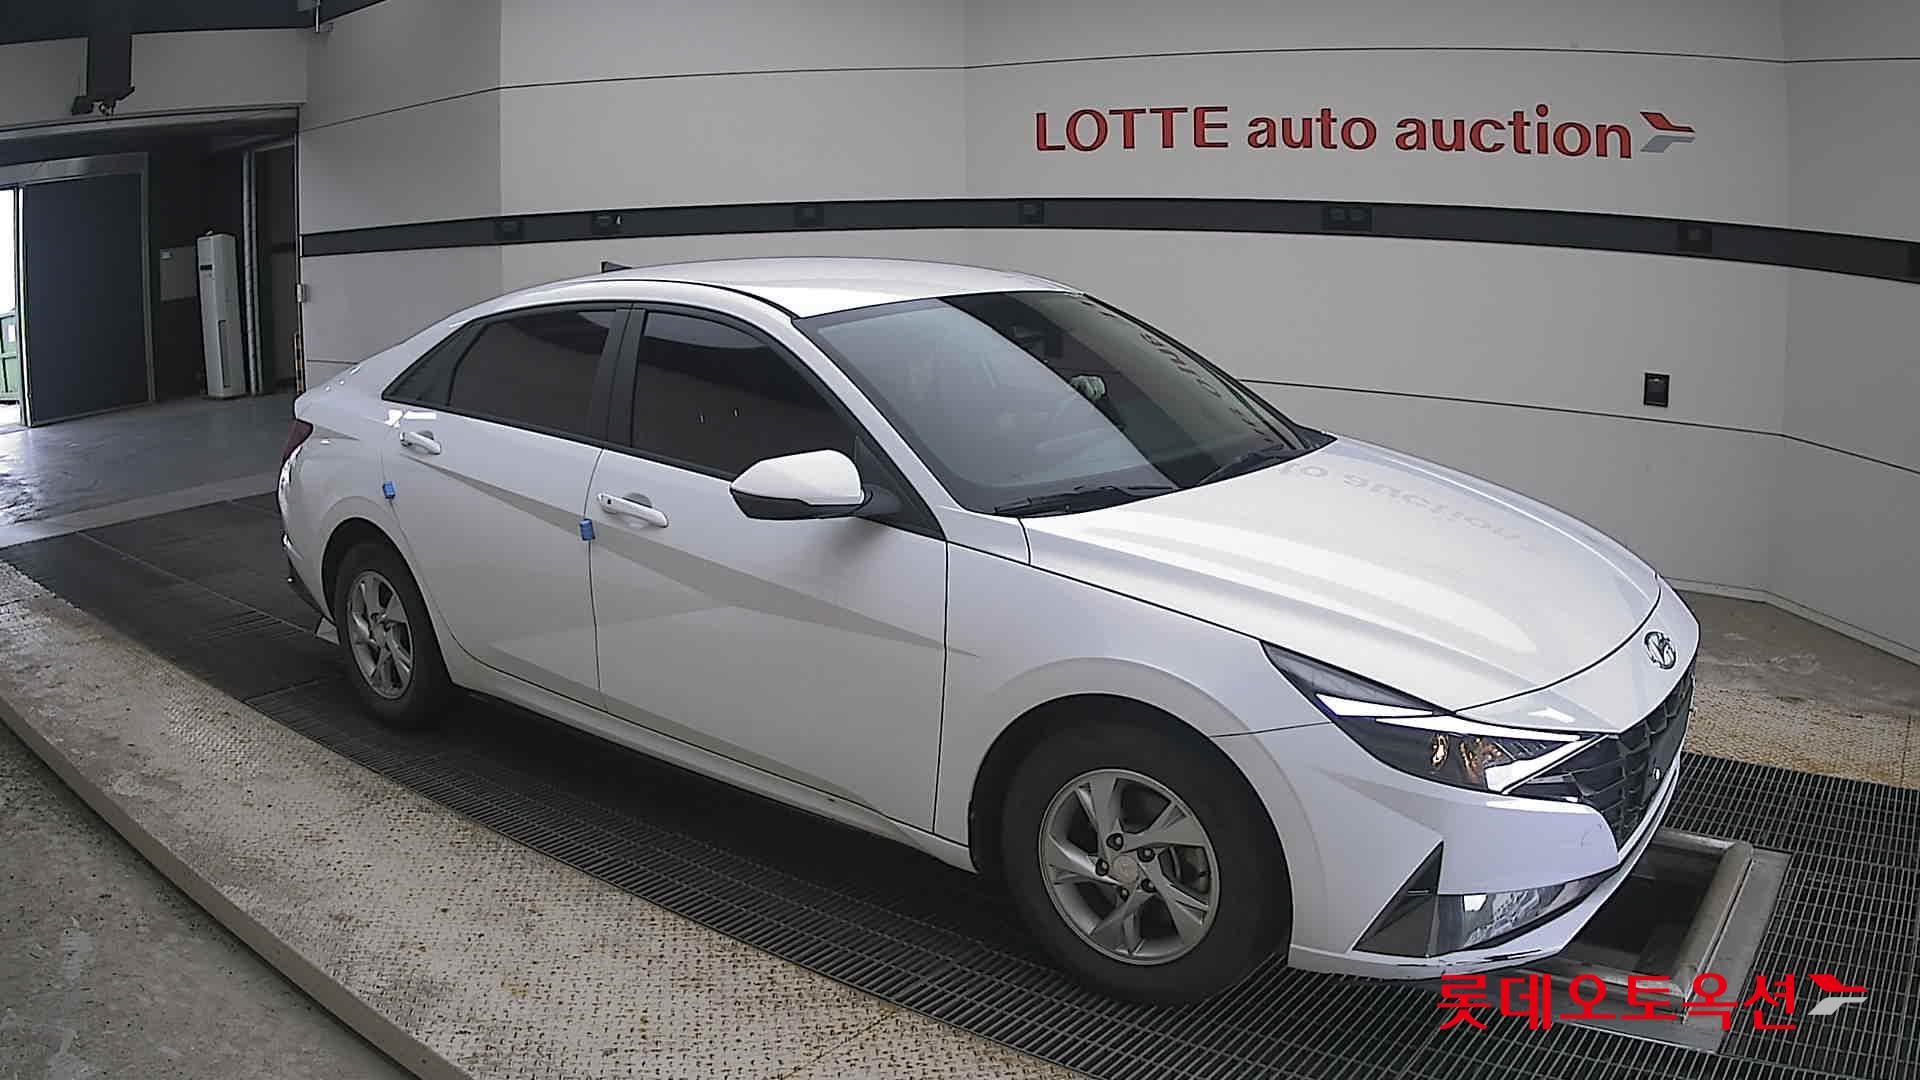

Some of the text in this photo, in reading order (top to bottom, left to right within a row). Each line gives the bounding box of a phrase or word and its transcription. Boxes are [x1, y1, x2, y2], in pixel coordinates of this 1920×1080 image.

[1035, 104, 1633, 159] LOTTE auto auction
